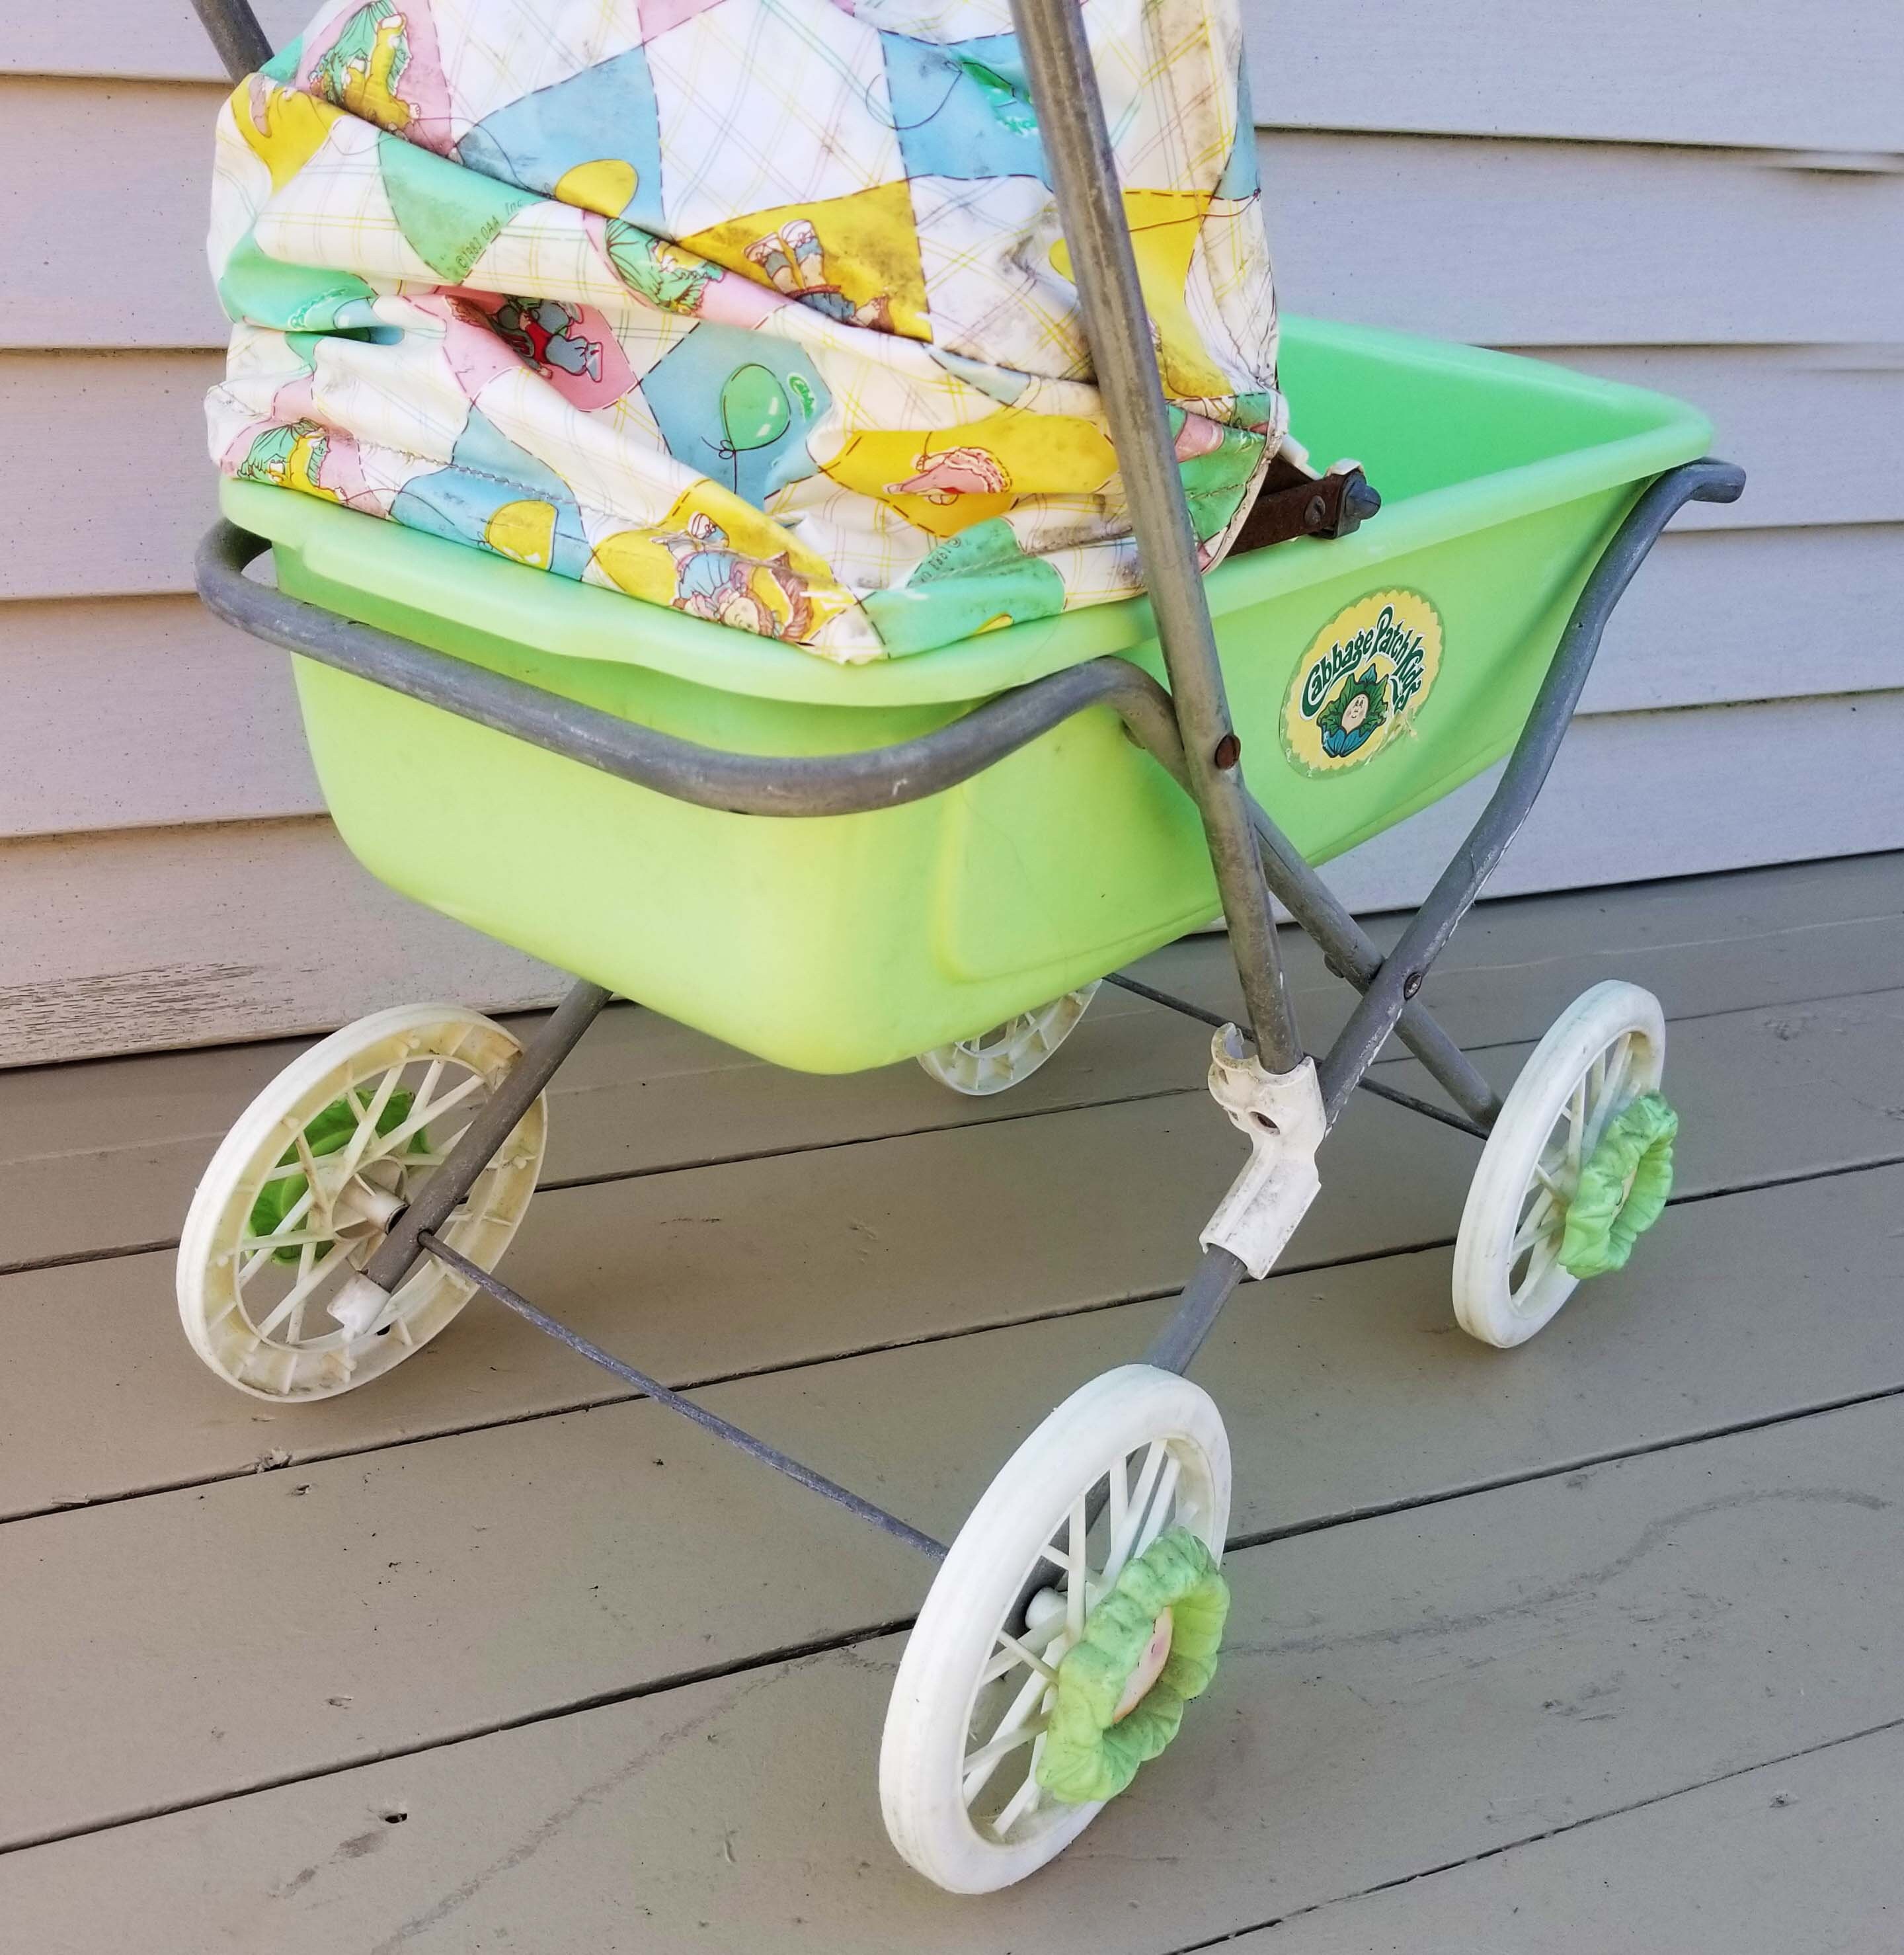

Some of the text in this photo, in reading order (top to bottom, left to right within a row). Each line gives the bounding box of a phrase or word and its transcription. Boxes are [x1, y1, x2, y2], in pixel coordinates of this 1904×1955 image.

[1300, 604, 1424, 719] Cabbage Patch Kids
